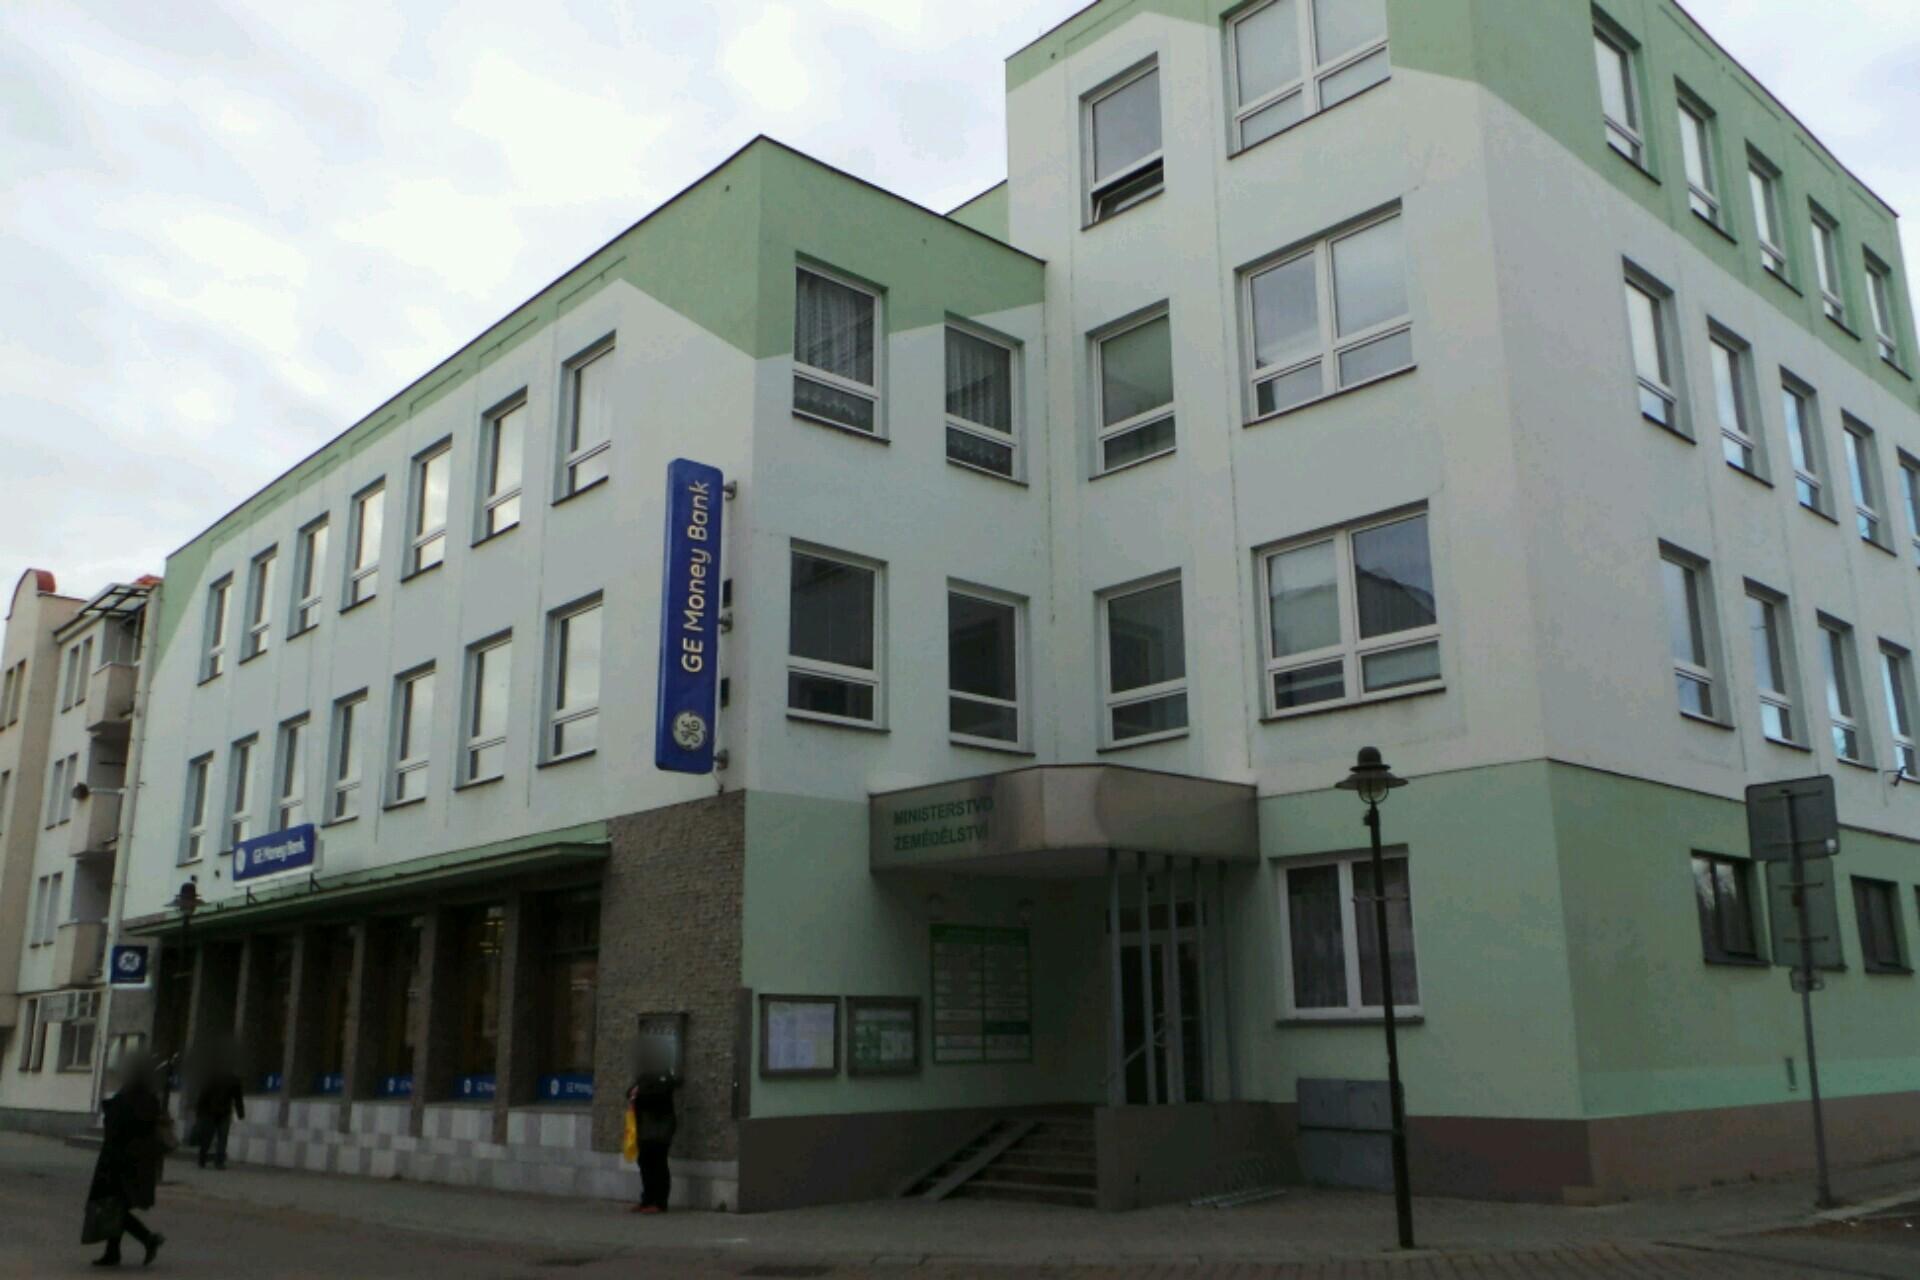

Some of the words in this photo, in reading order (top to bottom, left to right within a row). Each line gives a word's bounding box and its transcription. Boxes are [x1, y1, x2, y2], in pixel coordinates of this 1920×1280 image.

[687, 479, 710, 541] Bank
[683, 547, 713, 634] Money
[681, 638, 704, 673] GE
[894, 797, 994, 824] MINISTERSTVO
